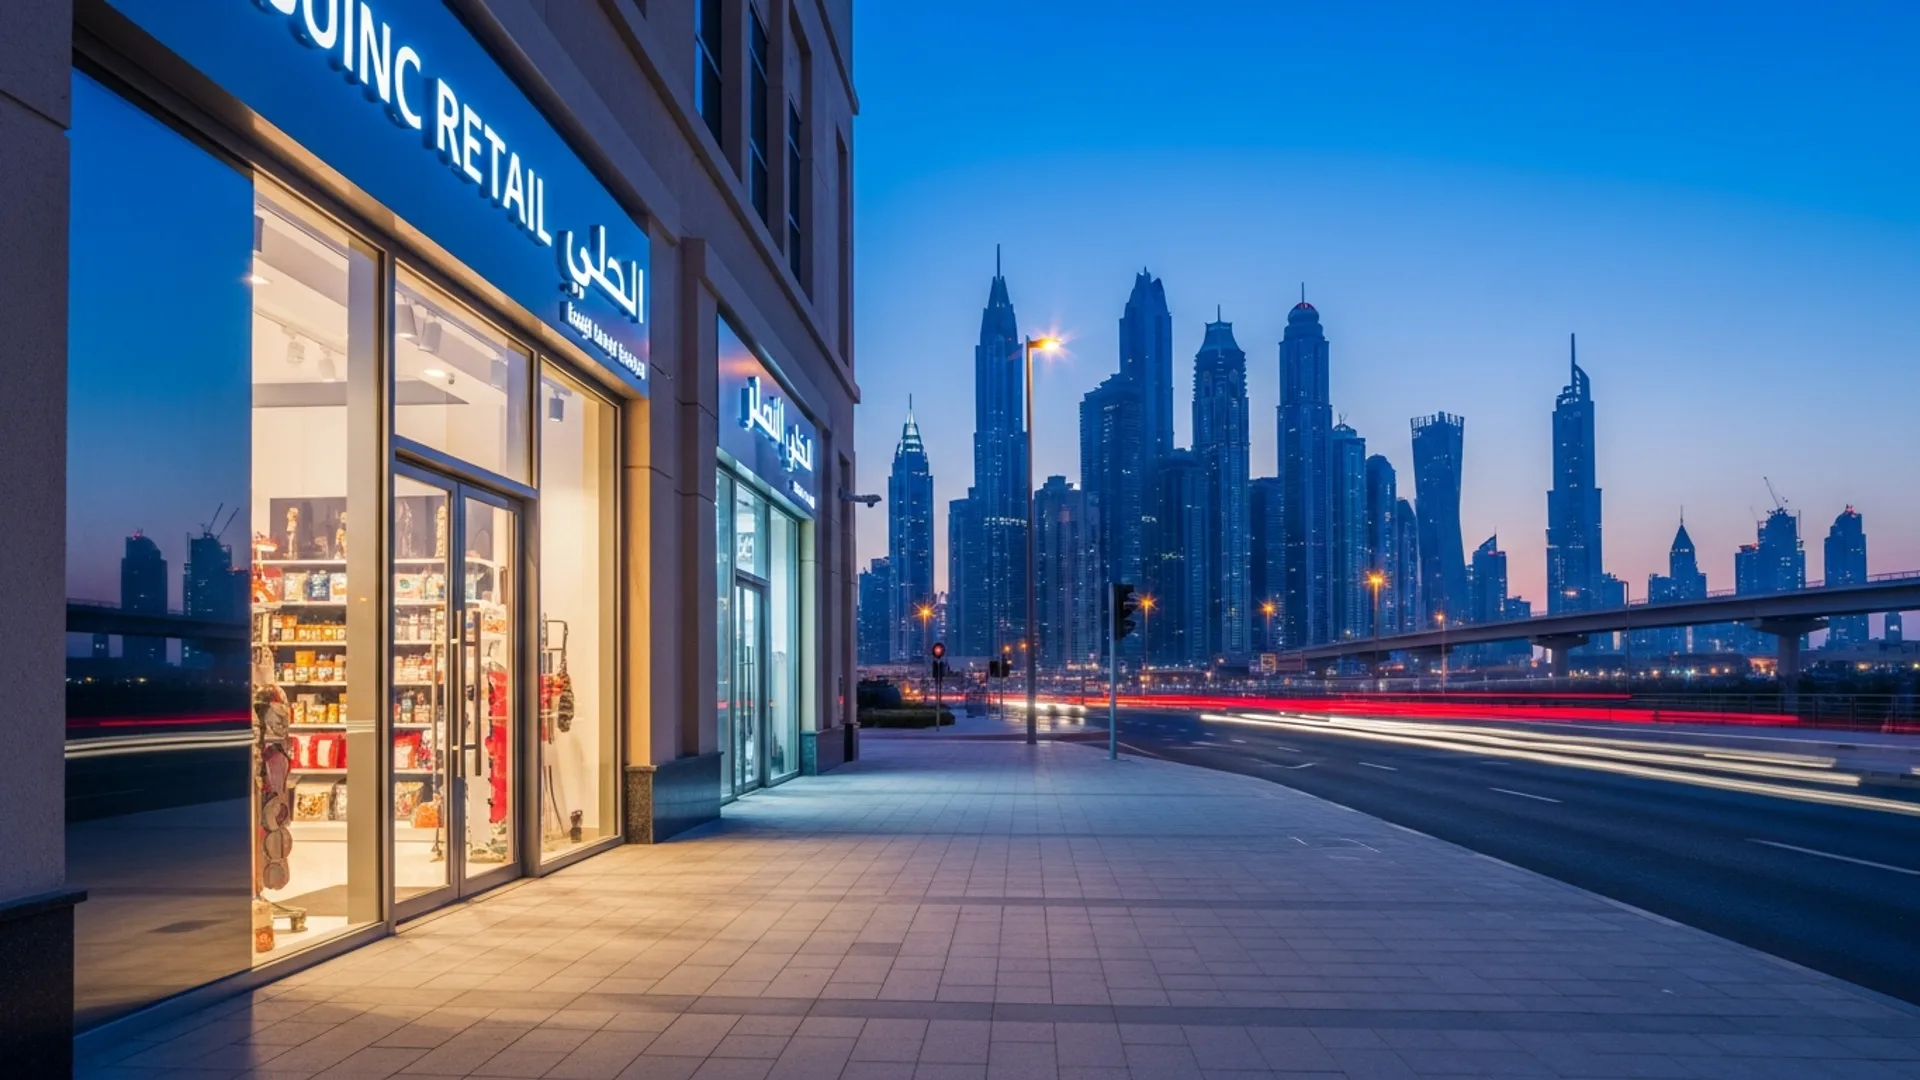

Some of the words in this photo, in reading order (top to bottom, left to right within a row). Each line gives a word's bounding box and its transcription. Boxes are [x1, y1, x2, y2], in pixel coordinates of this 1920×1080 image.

[268, 0, 422, 130] UINC
[437, 78, 552, 247] RETAIL
[566, 225, 644, 324] الحلي
